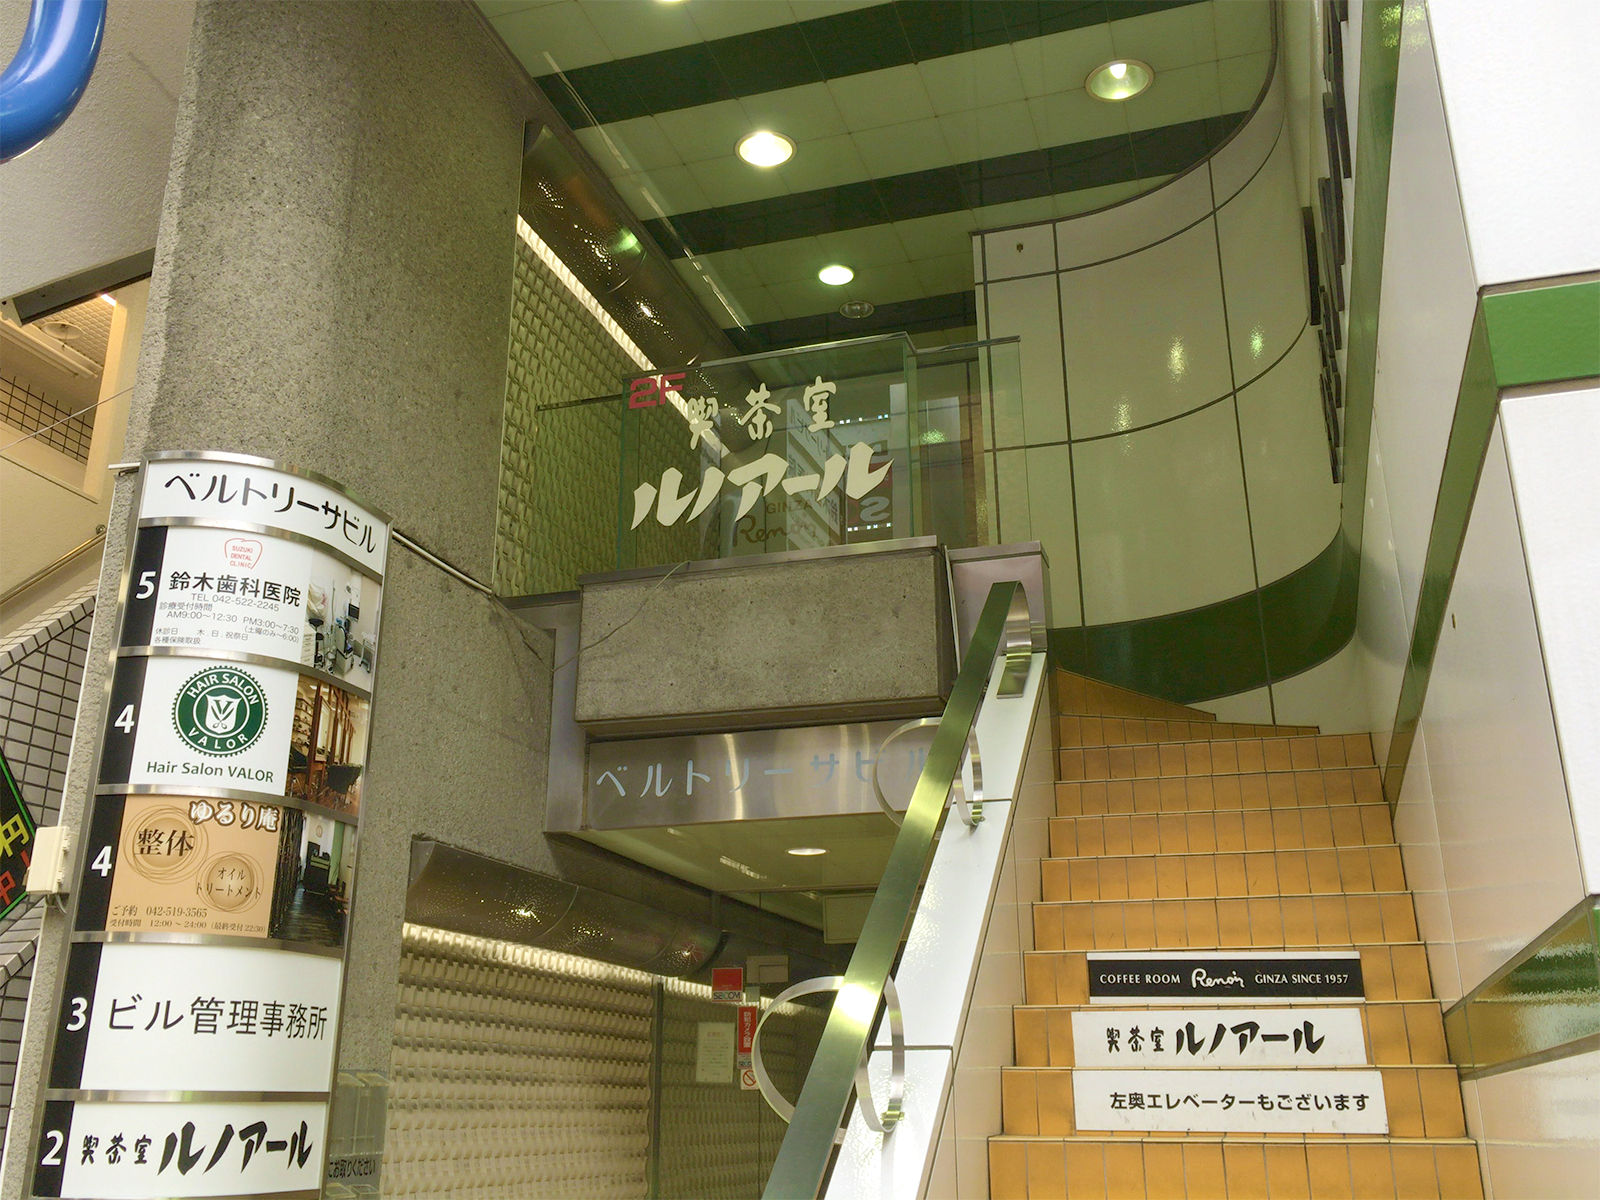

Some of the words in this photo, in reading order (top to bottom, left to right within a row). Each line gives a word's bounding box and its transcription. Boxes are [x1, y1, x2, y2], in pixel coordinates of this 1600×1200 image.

[628, 372, 686, 409] 2F
[630, 441, 895, 531] ルノアール
[165, 471, 377, 554] ベルトリーサビル
[230, 553, 252, 561] DENTAL
[232, 545, 253, 553] SUZUKI
[136, 571, 157, 599] 5
[169, 571, 301, 607] 鈴木歯科医院
[159, 601, 213, 612] 診療受付時間
[191, 593, 208, 601] TEL
[212, 595, 279, 612] 042-522-2245
[154, 637, 201, 645] 各種保険取扱
[187, 674, 219, 699] HAIR
[221, 673, 259, 705] SALON
[114, 704, 135, 733] 4
[188, 727, 248, 749] VALOR
[146, 761, 178, 774] Hair
[182, 762, 223, 776] Salon
[228, 766, 274, 783] VALOR
[189, 801, 280, 832] ゆるり庵
[134, 828, 195, 857] 整体
[91, 845, 113, 877] 4
[218, 867, 246, 881] オイル
[196, 882, 261, 899] トリートメント
[109, 919, 142, 928] 受付時間
[112, 905, 138, 917] ご予約
[146, 906, 207, 918] 042-519-3565
[1099, 973, 1141, 984] COFFEE
[1145, 973, 1181, 984] ROOM
[1191, 967, 1245, 989] Renoir
[1254, 973, 1289, 985] GINZA
[1292, 973, 1322, 984] SINCE
[1324, 973, 1349, 985] 1957
[713, 992, 741, 1000] SECOM
[65, 997, 88, 1032] 3
[108, 993, 328, 1041] ビル管理事務所
[1175, 1020, 1326, 1056] ルノアール
[1109, 1092, 1370, 1111] 左奥エレベーターもございます
[41, 1130, 65, 1166] 2
[157, 1120, 314, 1176] ルノアール
